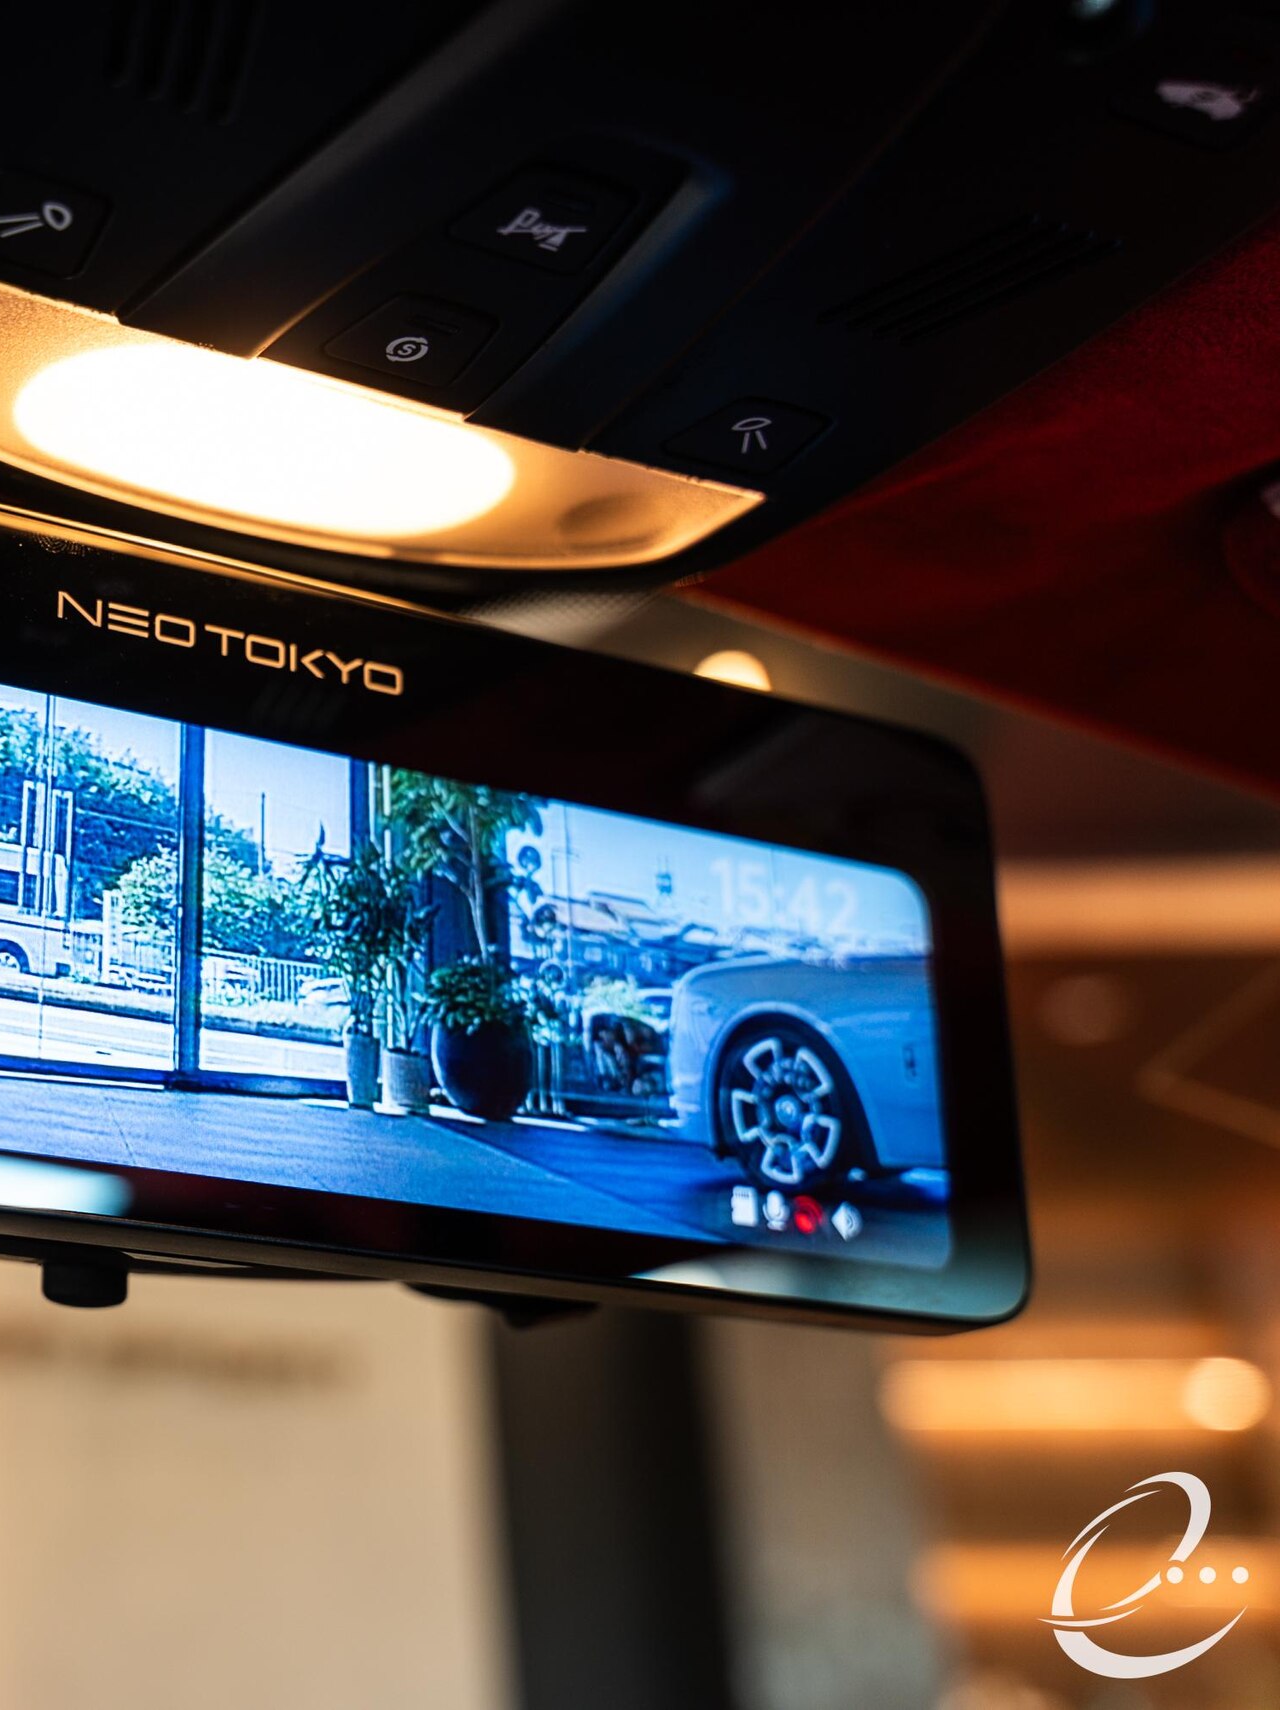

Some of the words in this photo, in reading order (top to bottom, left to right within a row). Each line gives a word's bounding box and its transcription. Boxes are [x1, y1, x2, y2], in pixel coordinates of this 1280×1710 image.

[56, 590, 196, 648] NEO
[205, 624, 405, 697] TOKYO
[709, 857, 859, 936] 15:42
